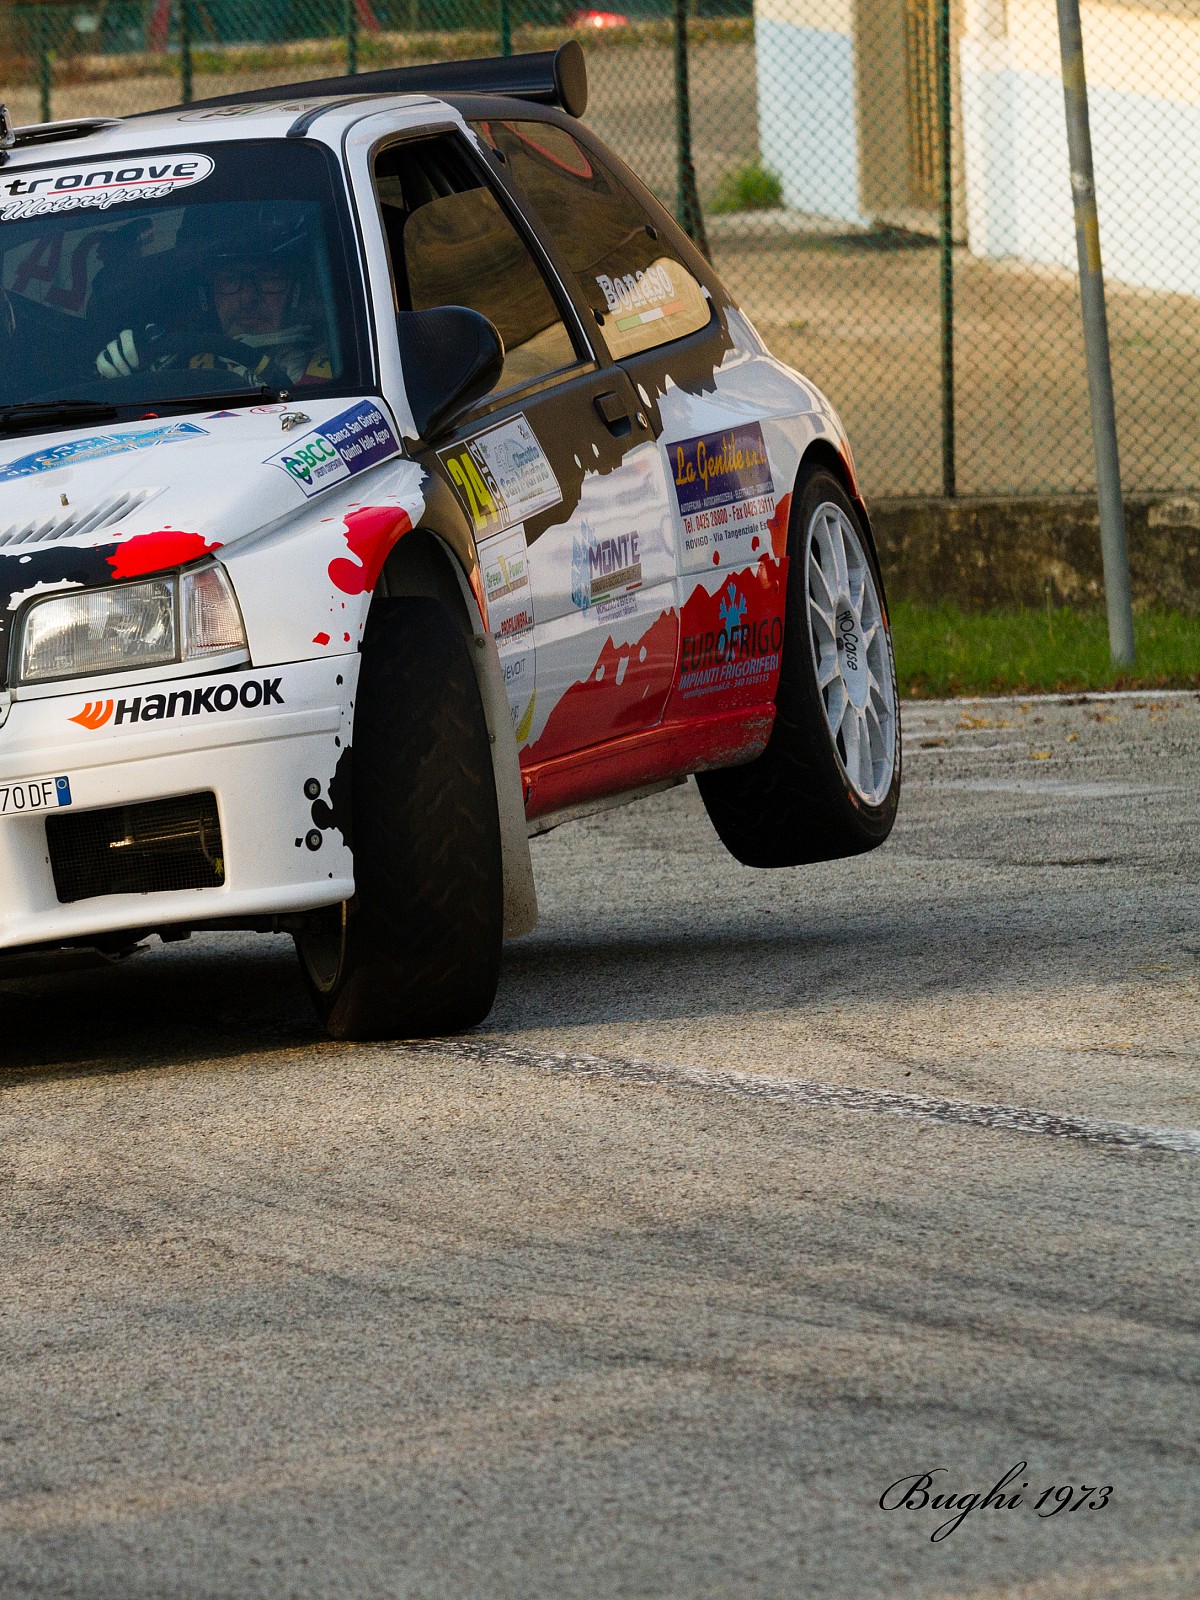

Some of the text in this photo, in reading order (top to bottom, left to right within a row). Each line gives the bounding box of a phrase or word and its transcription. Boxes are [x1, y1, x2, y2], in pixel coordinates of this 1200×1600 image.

[2, 182, 173, 220] Motorsport
[596, 264, 675, 315] Bonaso
[325, 409, 382, 445] Banca San Giorgio
[340, 428, 390, 461] Quinto Valle Agno
[294, 438, 336, 468] BCC
[676, 446, 697, 486] La
[697, 432, 745, 492] Gentile
[447, 452, 498, 531] 24
[683, 517, 696, 535] Tel.
[695, 512, 711, 531] 0425
[732, 505, 744, 521] Fax
[743, 500, 758, 519] 0425
[685, 536, 709, 551] ROVIGO
[713, 530, 724, 543] Via
[725, 521, 759, 540] Tangenziale
[589, 530, 641, 580] MONTE
[681, 616, 783, 673] EUROFRIGO
[678, 653, 779, 691] IMPIANTI FRIGORIFERI
